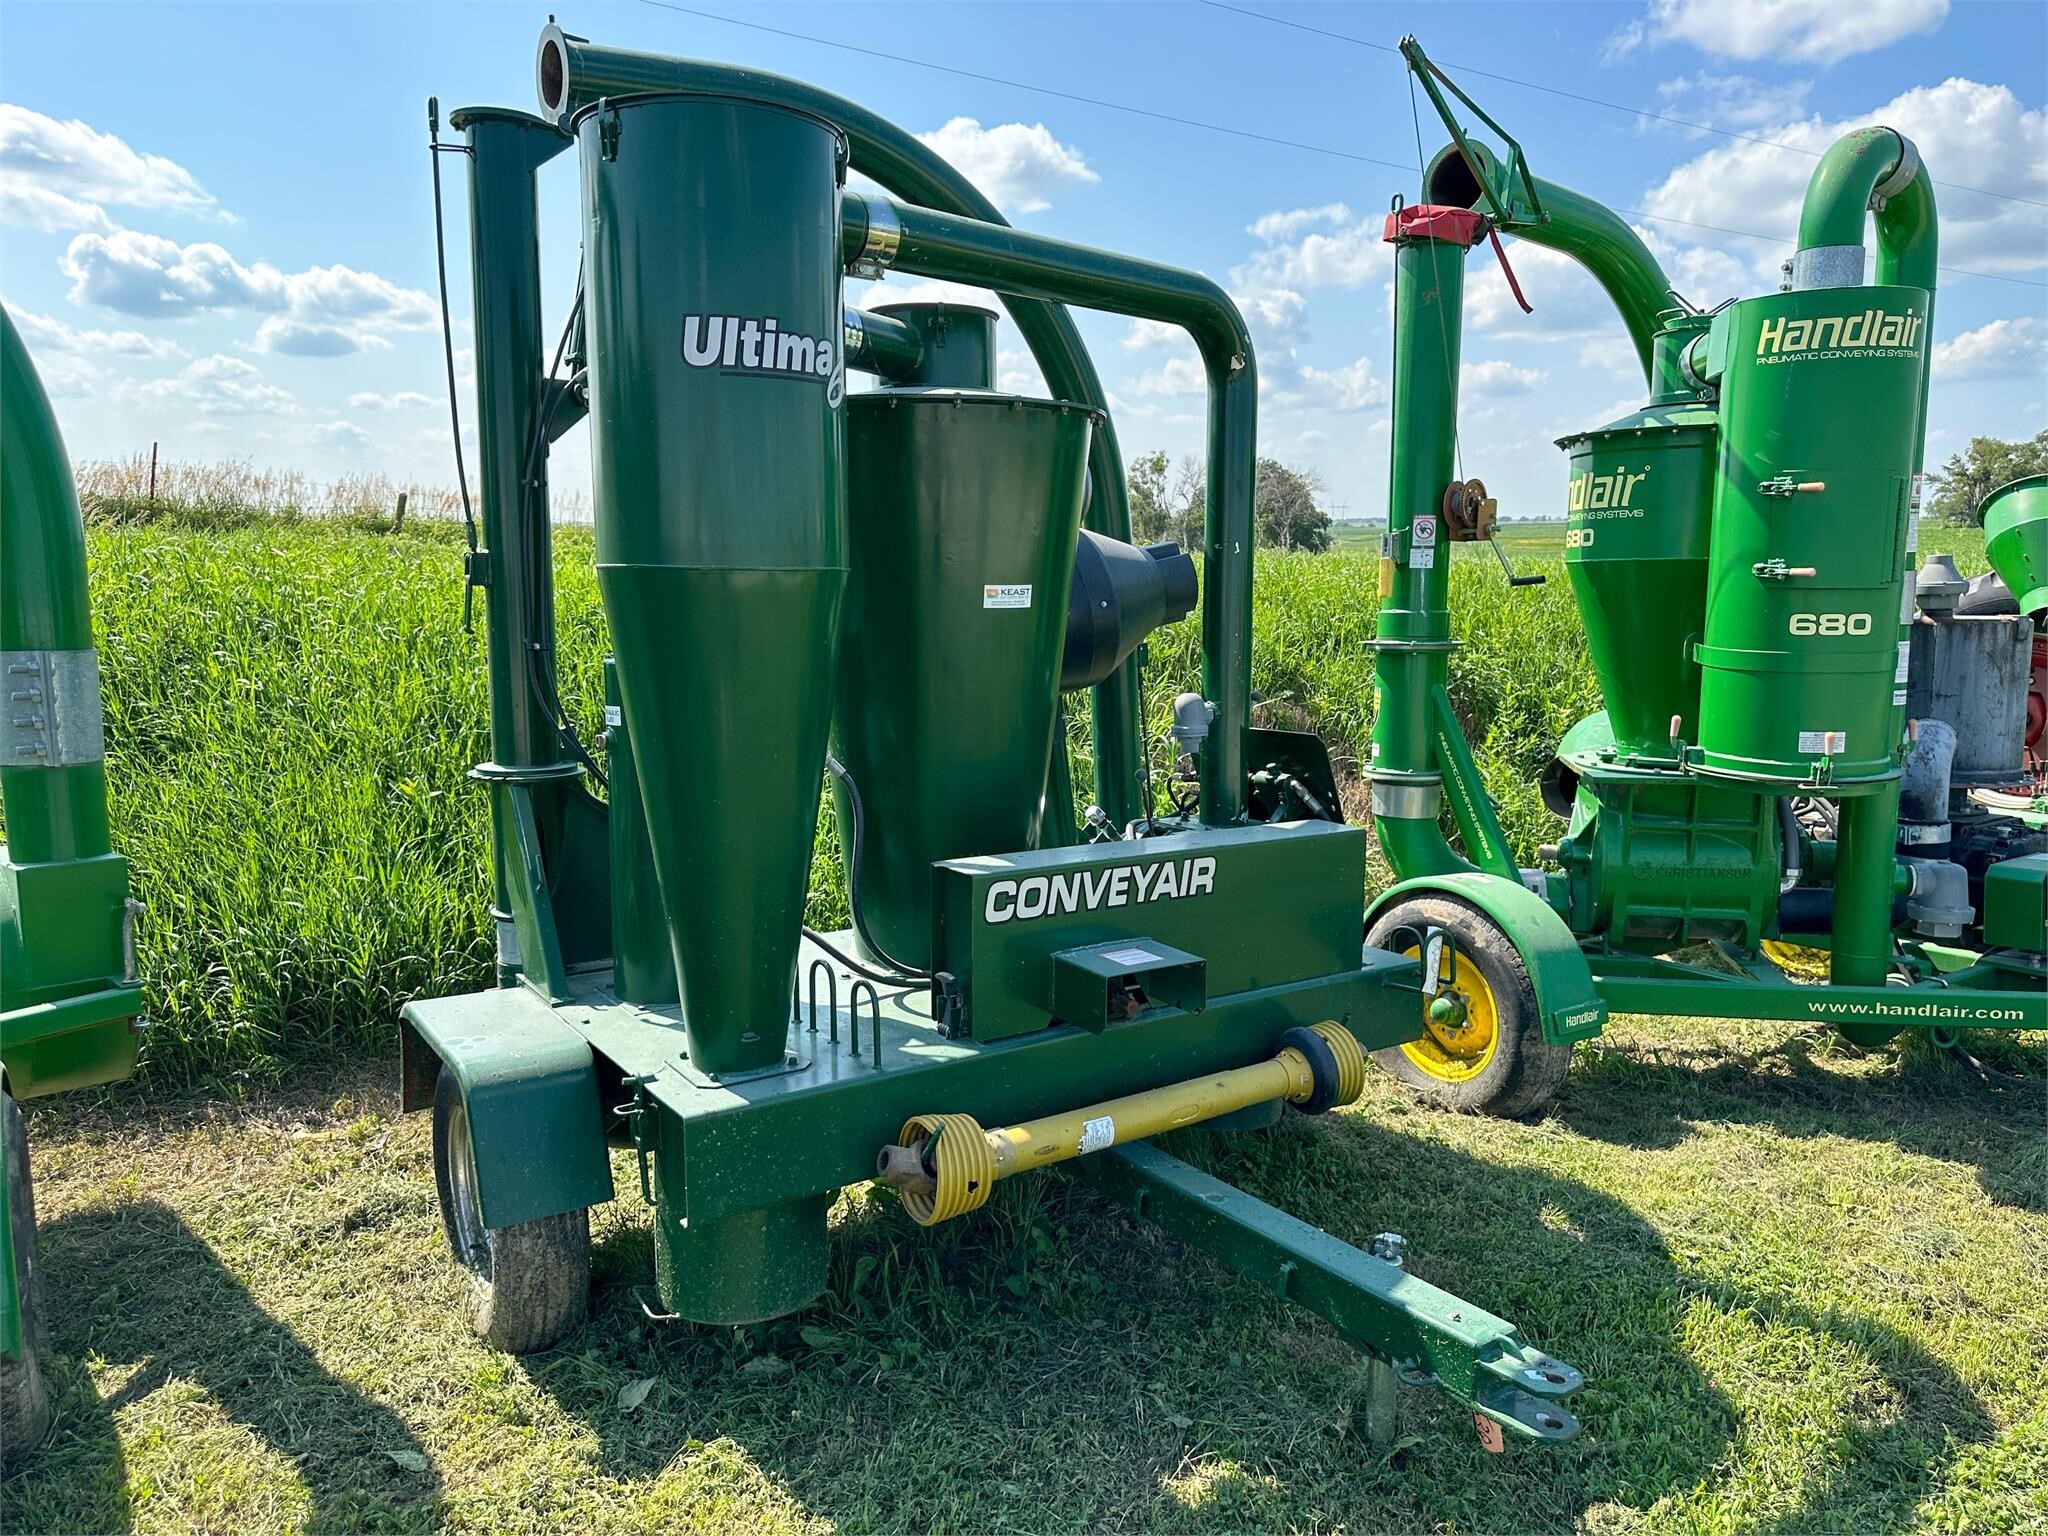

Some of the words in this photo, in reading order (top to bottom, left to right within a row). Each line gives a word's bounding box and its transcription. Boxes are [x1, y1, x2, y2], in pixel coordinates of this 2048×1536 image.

[1756, 308, 1922, 355] Handlair
[683, 316, 834, 377] Ultima
[1756, 351, 1818, 366] PNEUMATIC
[1820, 349, 1886, 360] CONVEYING
[1886, 348, 1920, 359] SYSTEMS
[1596, 509, 1644, 519] SYSTEMS
[1566, 528, 1595, 549] 680
[1000, 588, 1031, 596] KEAST
[1789, 613, 1872, 636] 680
[1438, 731, 1460, 777] PNEUMATIC
[1455, 775, 1478, 822] CONVEYING
[1473, 821, 1493, 860] SYSTEMS
[1656, 866, 1752, 880] CHRISTIANSON
[984, 856, 1217, 924] CONVEYAIR
[1565, 1009, 1600, 1028] Handlair
[1808, 1002, 2025, 1020] www.handlair.com
